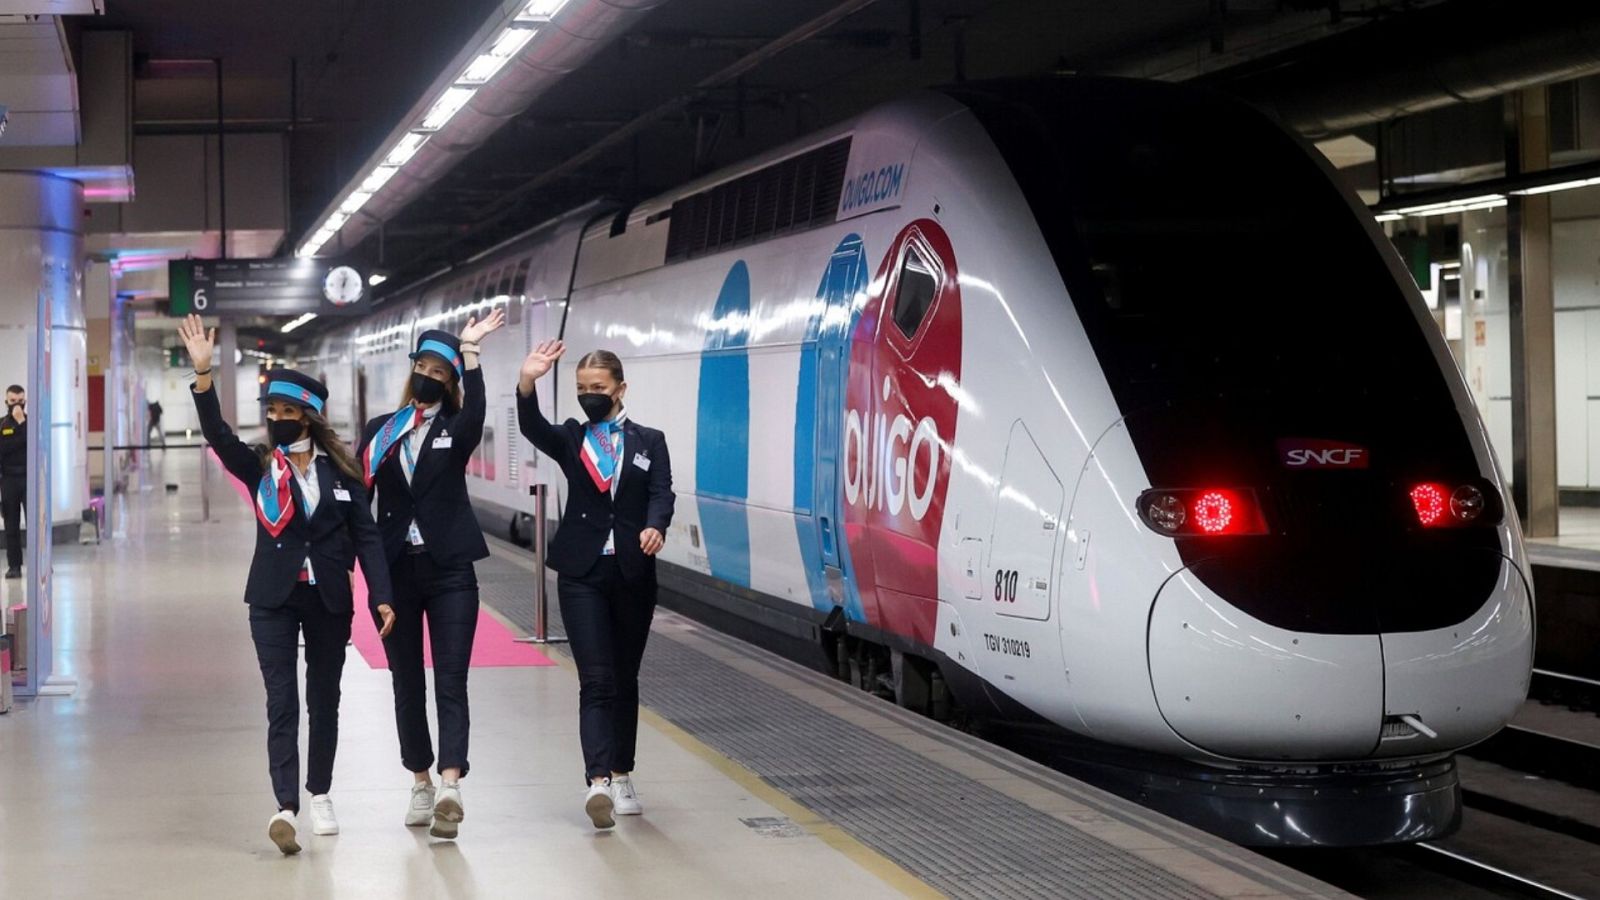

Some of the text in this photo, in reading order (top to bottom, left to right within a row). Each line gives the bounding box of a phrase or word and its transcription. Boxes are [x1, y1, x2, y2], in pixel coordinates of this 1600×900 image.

[194, 289, 208, 310] 6
[1286, 449, 1363, 465] SNCF
[994, 569, 1018, 603] 810
[984, 633, 1031, 658] TGV 310219
